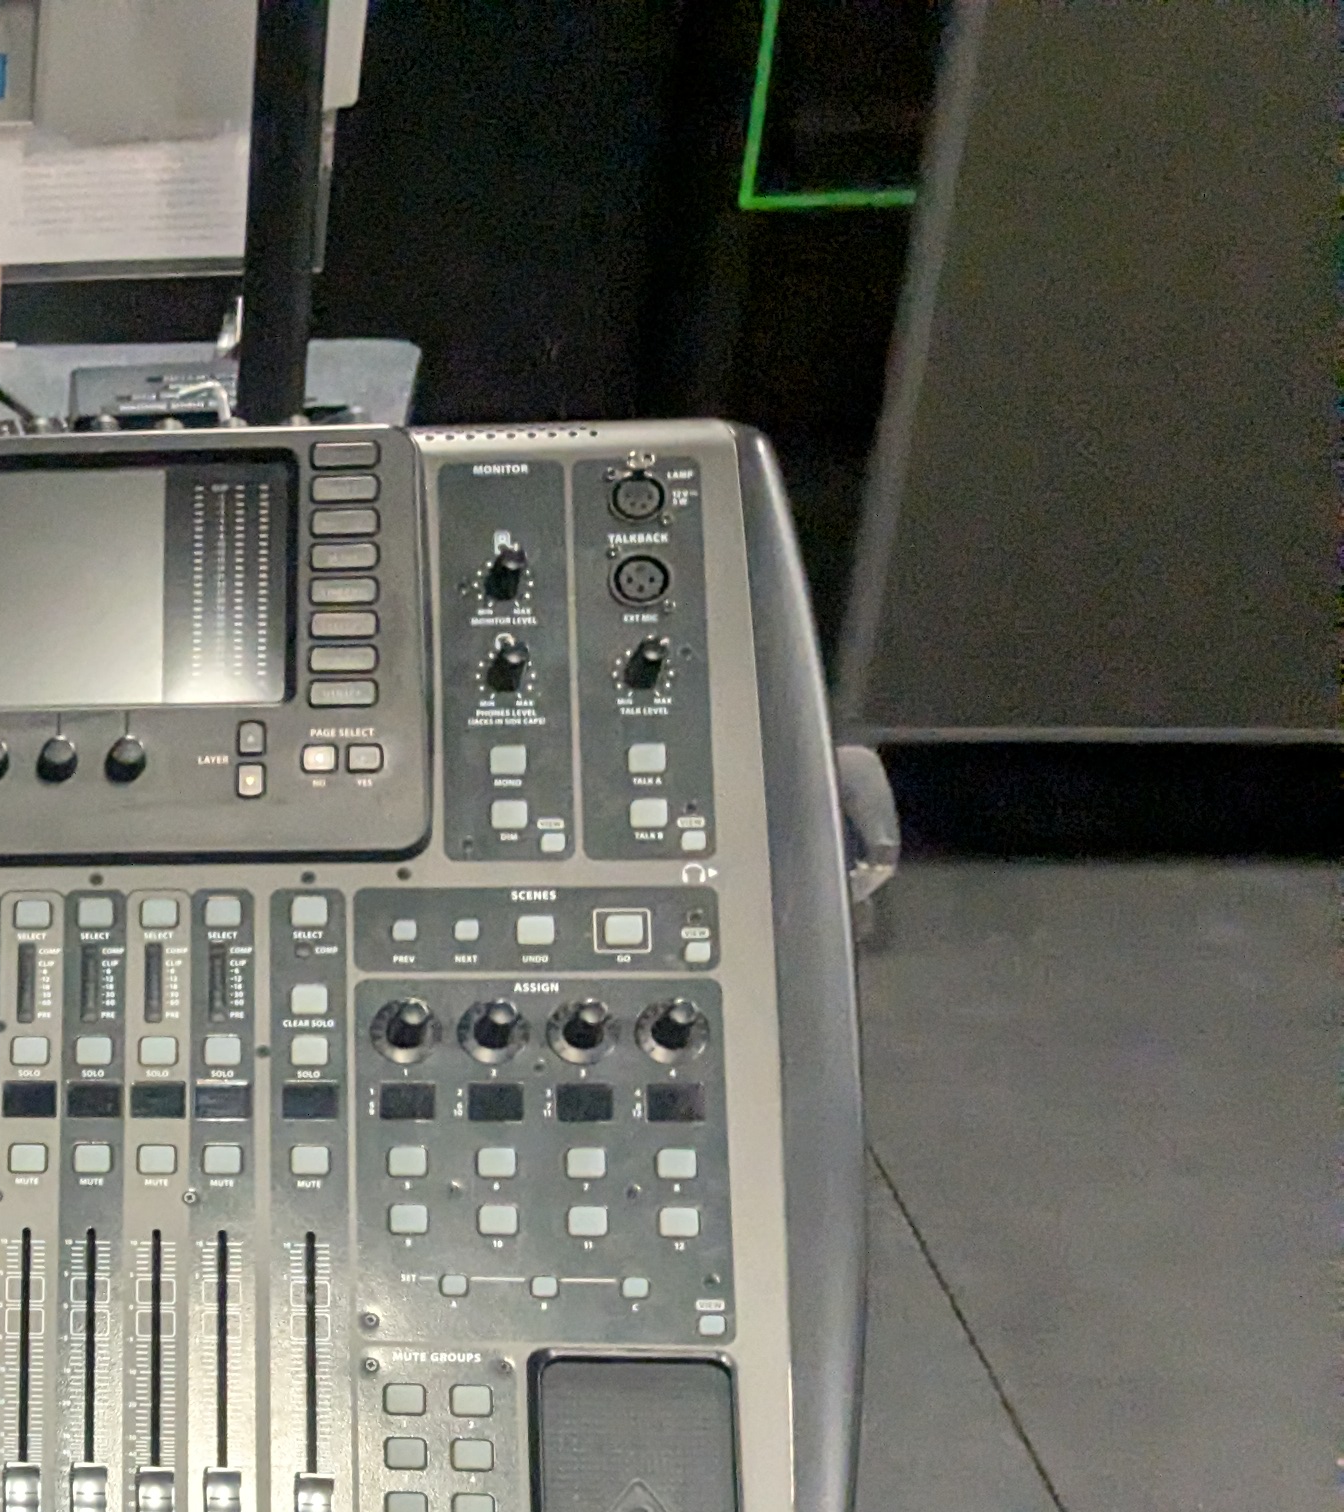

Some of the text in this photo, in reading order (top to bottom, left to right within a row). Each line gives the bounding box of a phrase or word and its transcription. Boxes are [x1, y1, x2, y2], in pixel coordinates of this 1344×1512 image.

[473, 464, 529, 475] MONITOR
[667, 471, 693, 479] LAMP
[608, 532, 669, 544] TALKBACK
[471, 616, 537, 625] MONITOR LEVEL
[620, 707, 668, 715] TALK LEVEL
[310, 728, 375, 738] PAGE SELECT
[198, 756, 229, 765] LAYER
[357, 779, 373, 787] YES
[494, 778, 522, 787] MONO
[633, 777, 653, 785] TALK
[511, 890, 557, 901] SCENES
[293, 931, 323, 940] SELECT
[393, 955, 416, 964] PREV
[454, 955, 478, 964] NEXT
[522, 955, 549, 964] UNDO
[617, 954, 631, 963] GO
[514, 982, 560, 993] ASSIGN
[283, 1019, 334, 1028] CLEAR SOLO
[297, 1070, 320, 1078] SOLO
[210, 1179, 234, 1188] MUTE
[297, 1180, 321, 1189] MUTE
[393, 1352, 481, 1363] MUTE GROUPS
